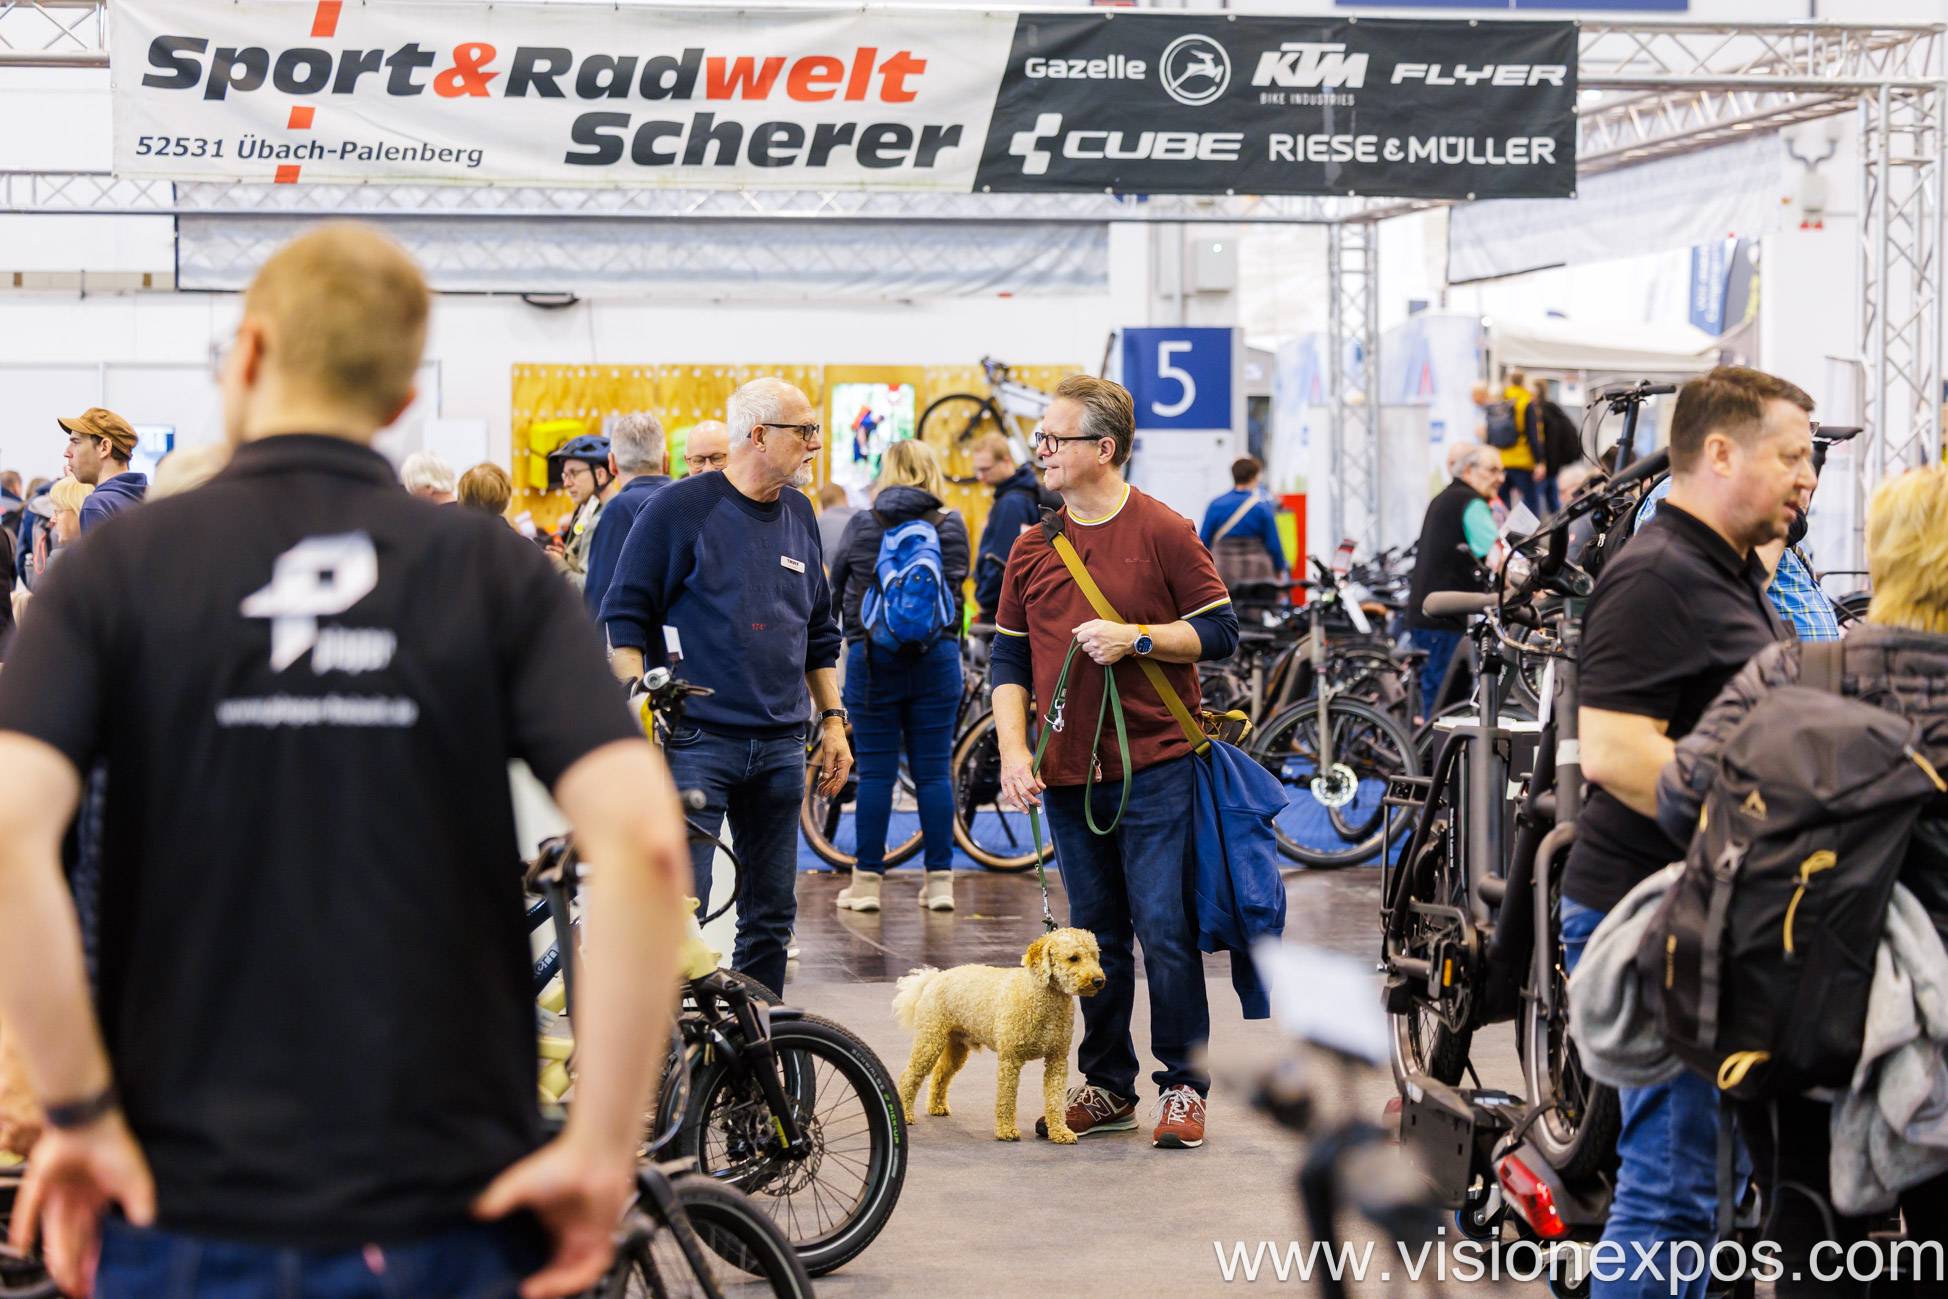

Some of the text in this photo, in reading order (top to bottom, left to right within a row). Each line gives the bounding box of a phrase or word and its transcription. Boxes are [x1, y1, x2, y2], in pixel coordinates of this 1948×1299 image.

[142, 35, 928, 104] Sport&Radwelt
[1025, 55, 1147, 80] Gazelle
[1252, 43, 1370, 88] KTM
[1391, 63, 1569, 88] FLYER
[1260, 93, 1355, 106] BIKE INDUSTRIES
[136, 134, 483, 168] 52531 Übach-Palenberg
[565, 112, 963, 168] Scherer
[1062, 131, 1245, 161] CUBE
[1269, 134, 1378, 162] RIESE
[1408, 136, 1556, 165] MÜLLER
[1152, 341, 1196, 417] 5
